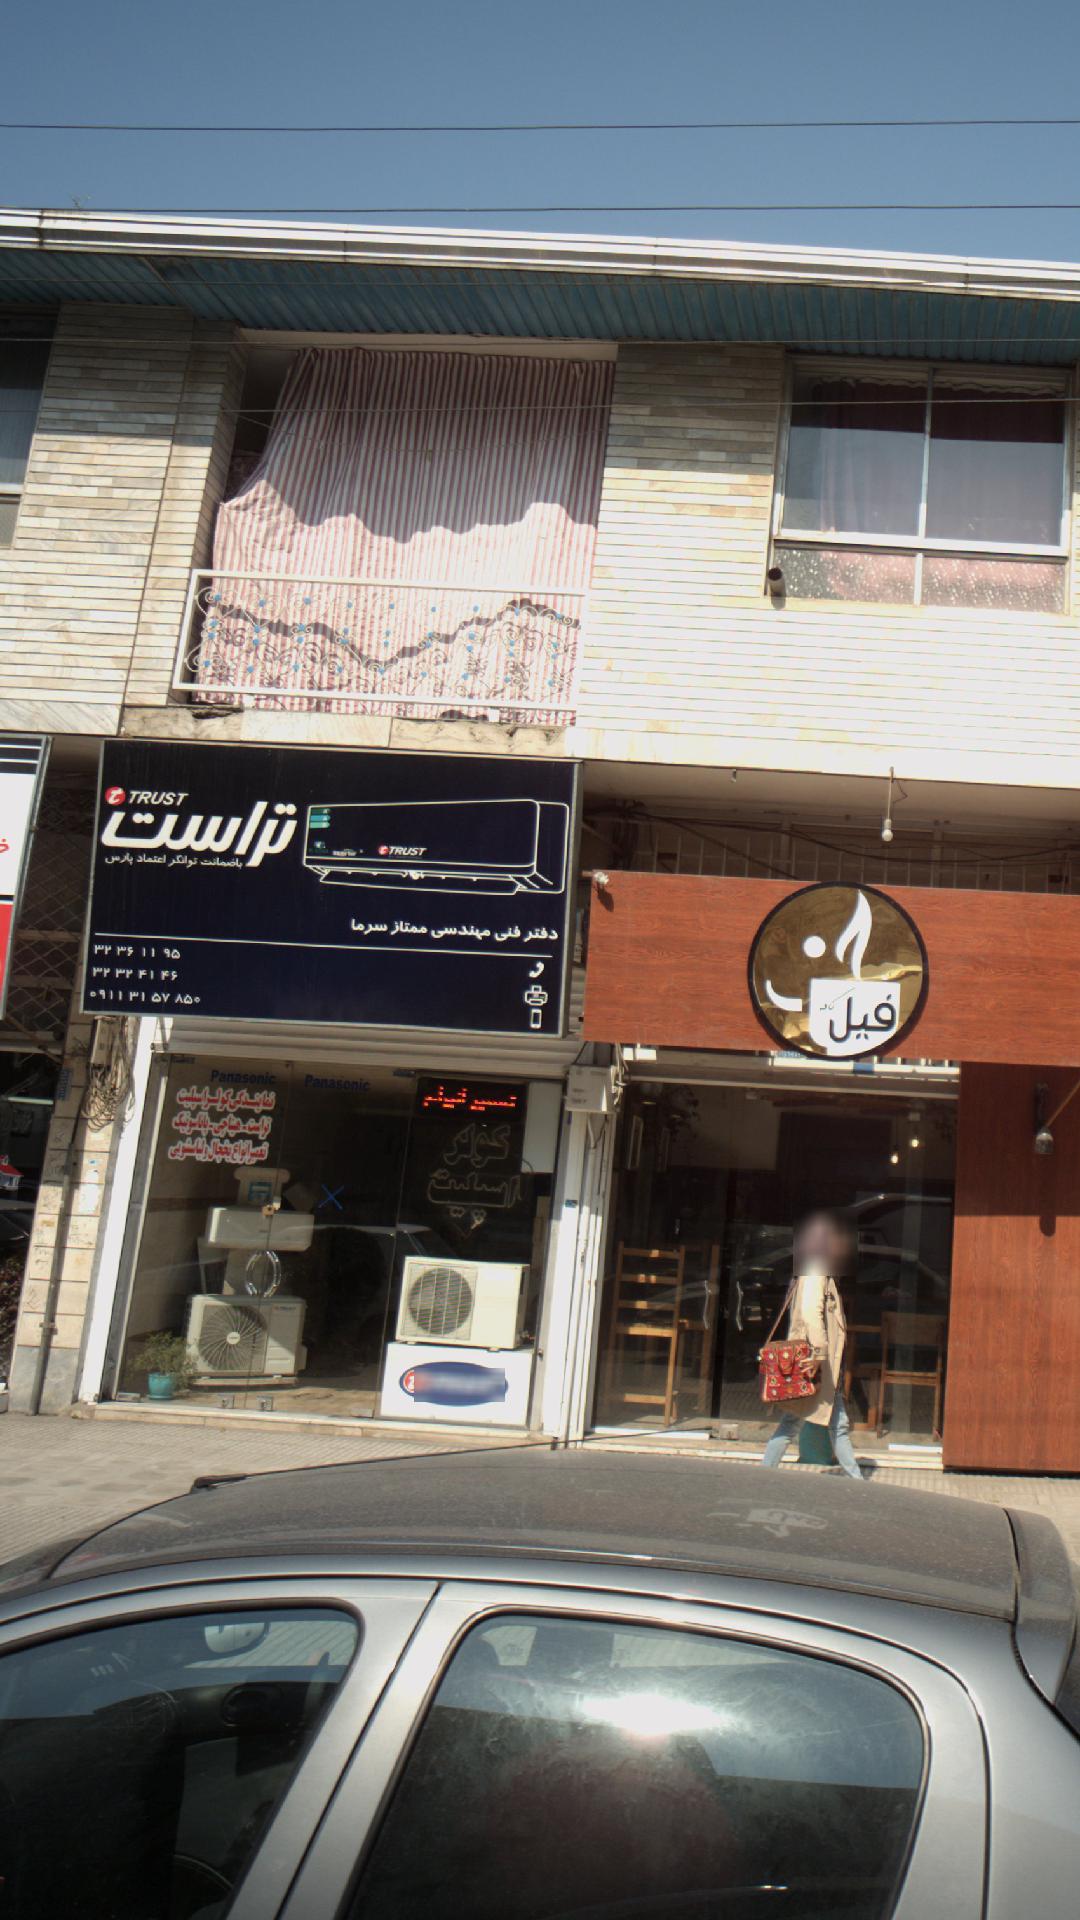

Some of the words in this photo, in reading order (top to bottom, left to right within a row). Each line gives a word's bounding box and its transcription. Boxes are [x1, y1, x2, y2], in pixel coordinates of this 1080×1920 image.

[128, 790, 189, 806] TRUST
[101, 801, 297, 868] تراست
[105, 852, 133, 866] پارس
[137, 853, 167, 865] اعتماد
[388, 846, 427, 856] TRUST
[168, 855, 198, 869] توانگر
[351, 918, 388, 935] سرما
[390, 920, 428, 936] ممتاز
[430, 923, 491, 940] مهندسی
[494, 925, 521, 942] فنی
[523, 926, 559, 943] دفتر
[829, 994, 897, 1043] فیل
[210, 1070, 276, 1085] Panasonic
[304, 1074, 371, 1092] Panasonic
